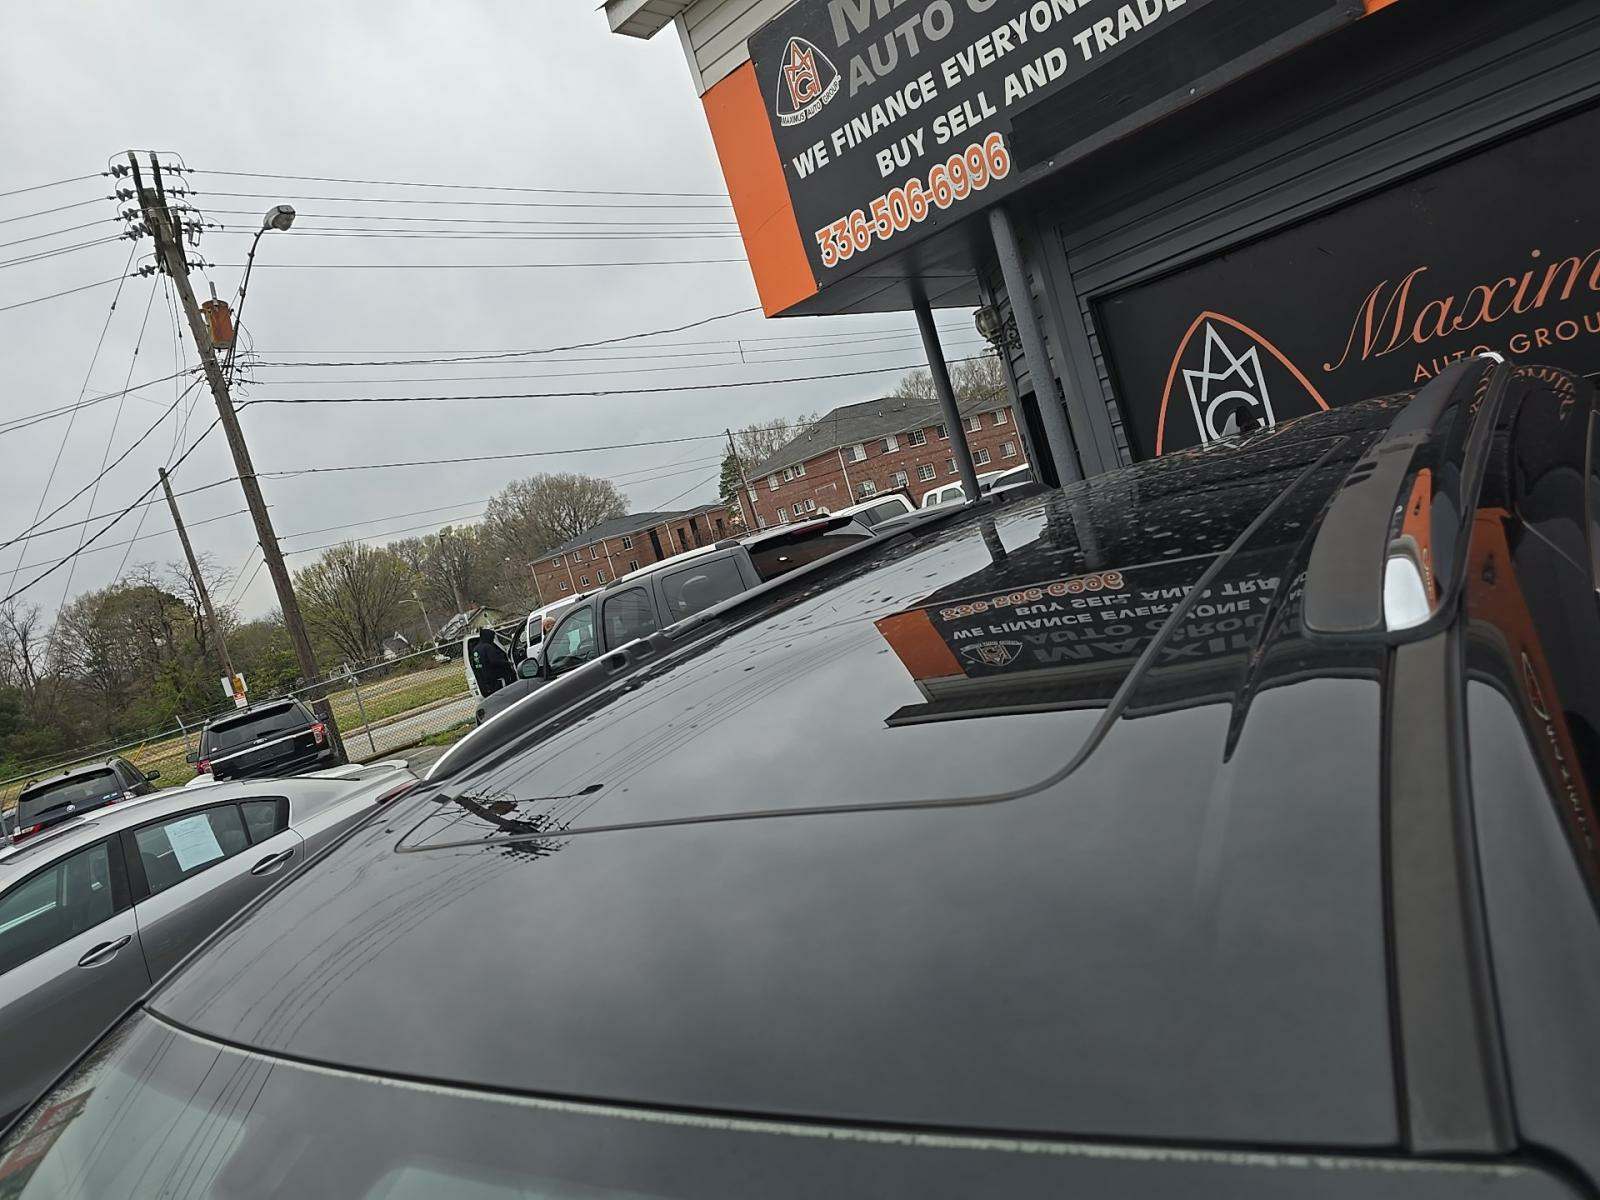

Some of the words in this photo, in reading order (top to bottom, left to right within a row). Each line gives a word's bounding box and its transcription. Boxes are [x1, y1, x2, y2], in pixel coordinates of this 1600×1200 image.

[849, 0, 954, 98] AUTO
[792, 140, 830, 179] WE
[831, 71, 938, 157] FINANCE
[875, 128, 925, 178] BUY
[933, 91, 997, 145] SELL
[1005, 47, 1068, 106] AND
[815, 132, 1011, 268] 336-506-6996
